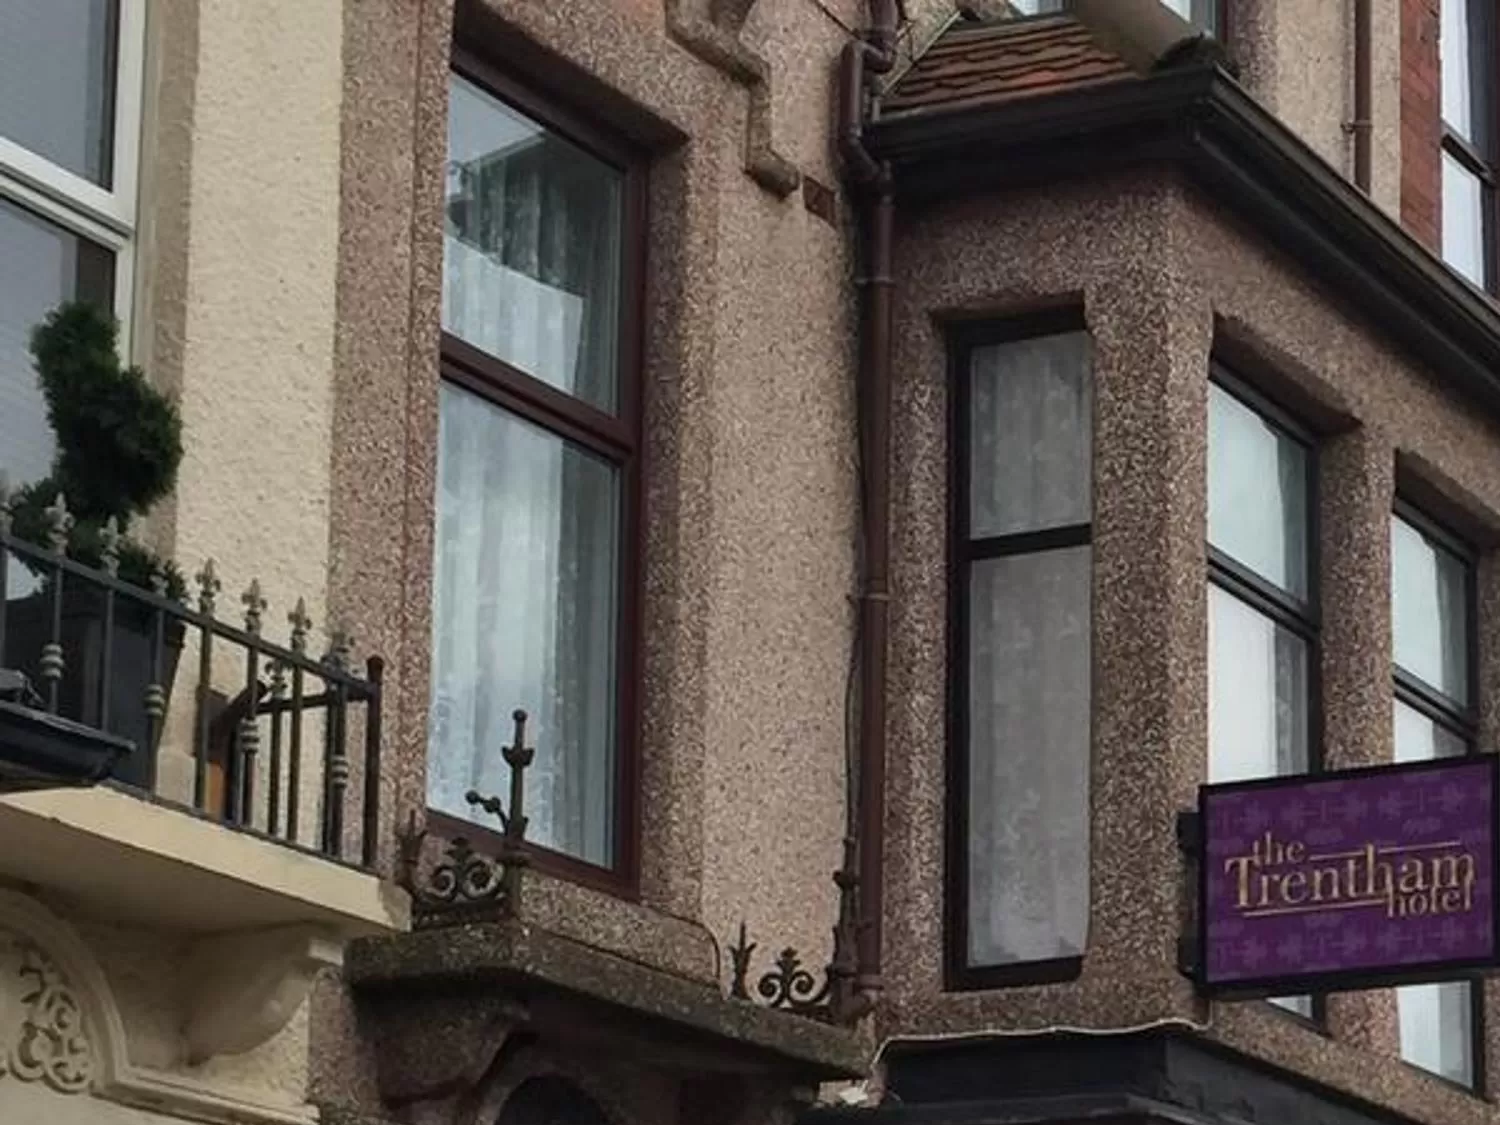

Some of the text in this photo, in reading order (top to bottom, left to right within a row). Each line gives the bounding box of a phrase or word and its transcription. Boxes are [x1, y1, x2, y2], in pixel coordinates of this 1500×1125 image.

[1251, 831, 1305, 866] the
[1224, 843, 1475, 910] Trentham
[1386, 882, 1473, 918] hotel
